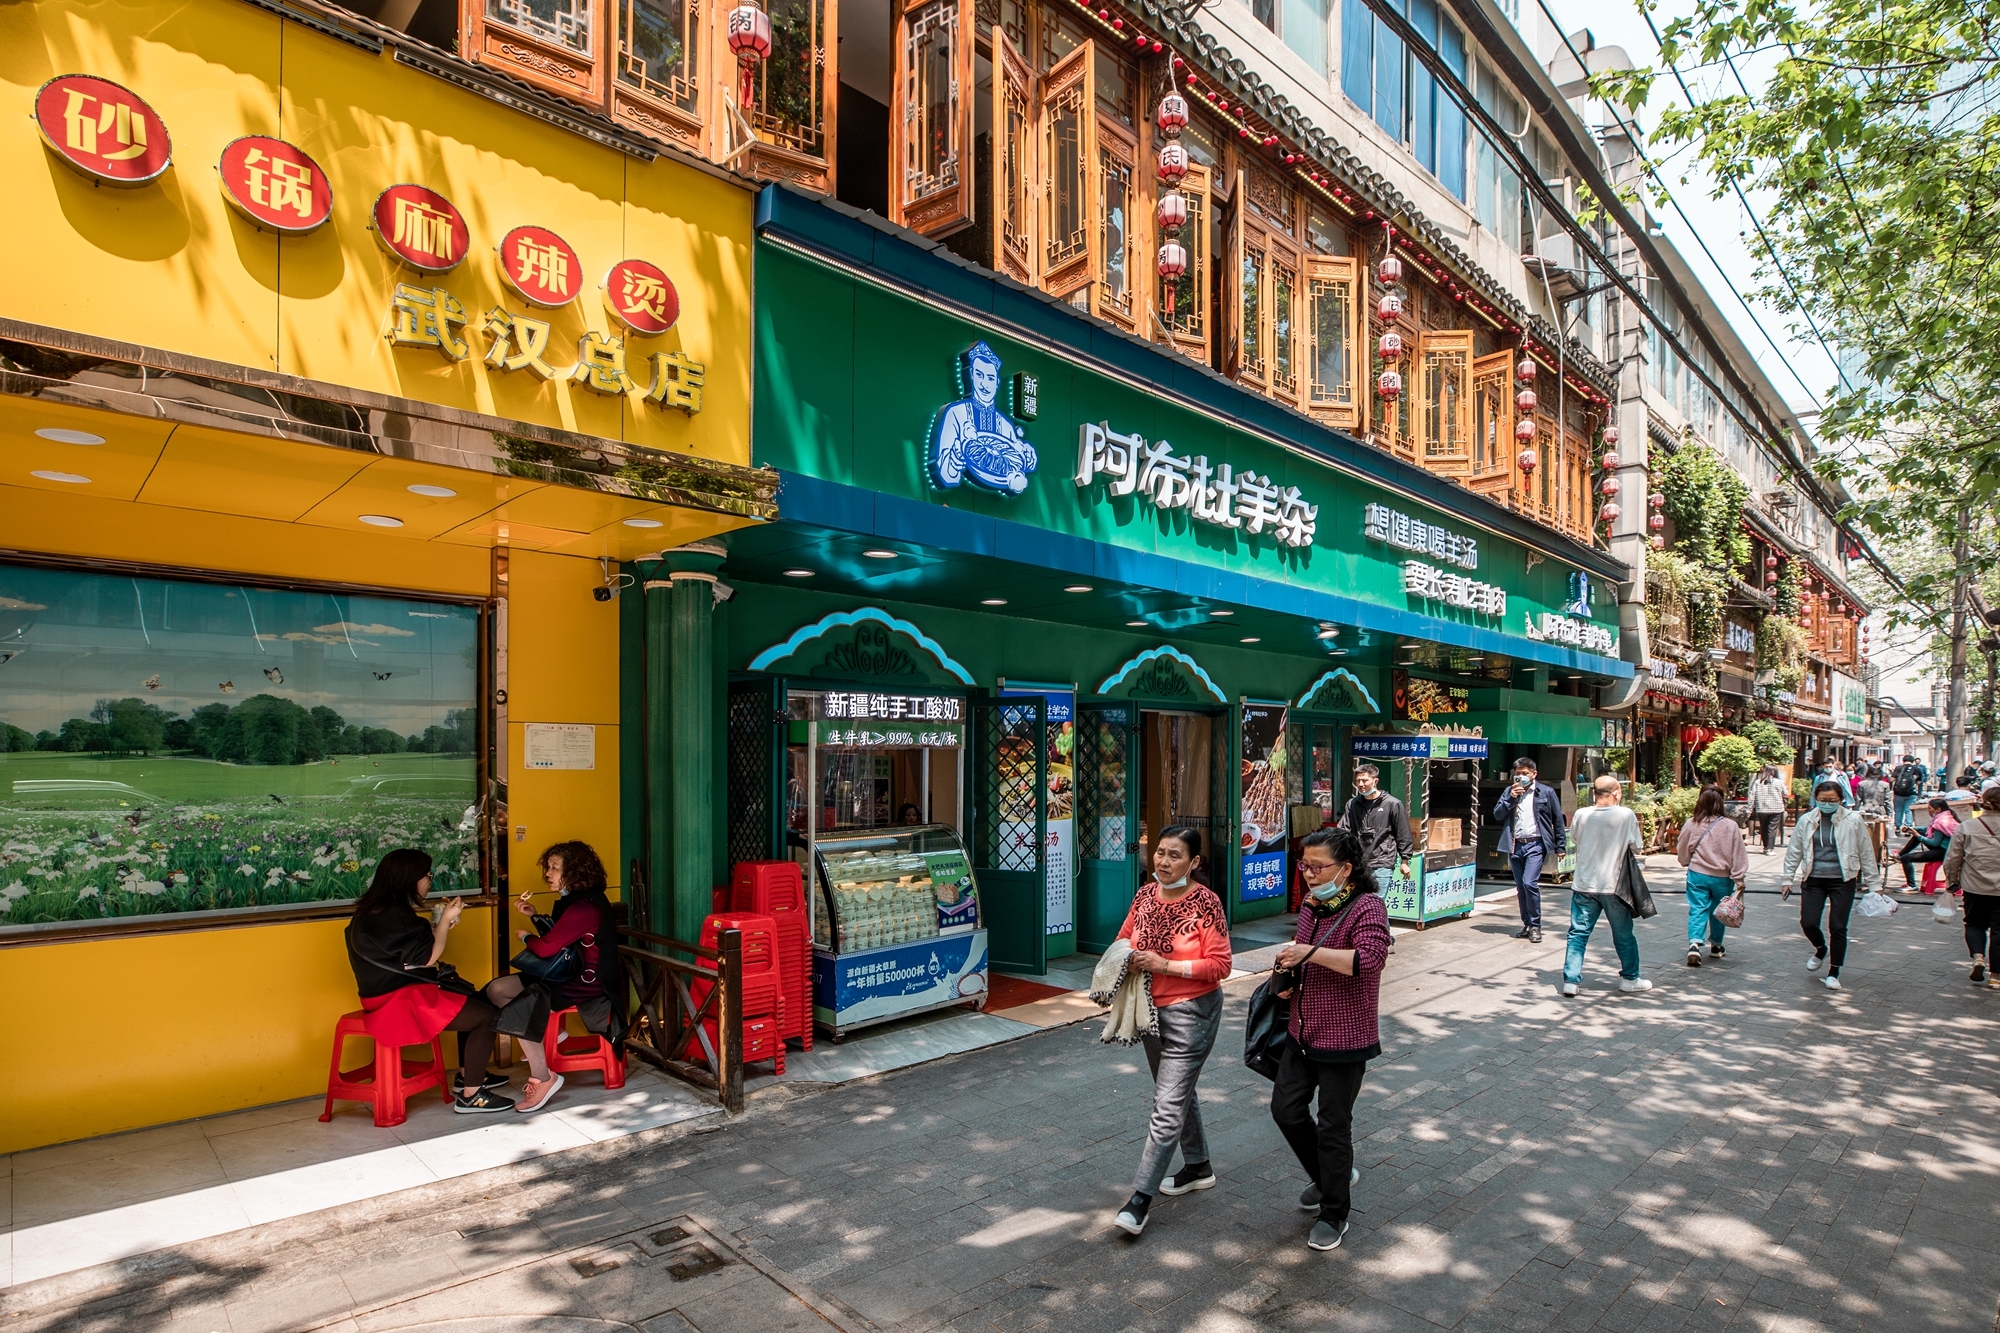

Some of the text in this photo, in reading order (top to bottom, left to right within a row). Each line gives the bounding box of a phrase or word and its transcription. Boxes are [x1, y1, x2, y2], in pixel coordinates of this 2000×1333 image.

[730, 12, 752, 34] 锅
[62, 86, 667, 325] 砂锅麻辣烫
[391, 282, 706, 417] 武汉总店
[1023, 375, 1038, 416] 新疆
[1075, 420, 1319, 547] 阿布杜羊杂
[1365, 502, 1478, 570] 想健康喝羊汤
[1405, 559, 1507, 617] 要长寿吃羊肉
[825, 691, 960, 721] 新疆纯手工酸奶
[1244, 859, 1281, 876] 源自新疆
[1247, 874, 1283, 892] 现宰活羊
[846, 964, 926, 989] 一年销量500000杯
